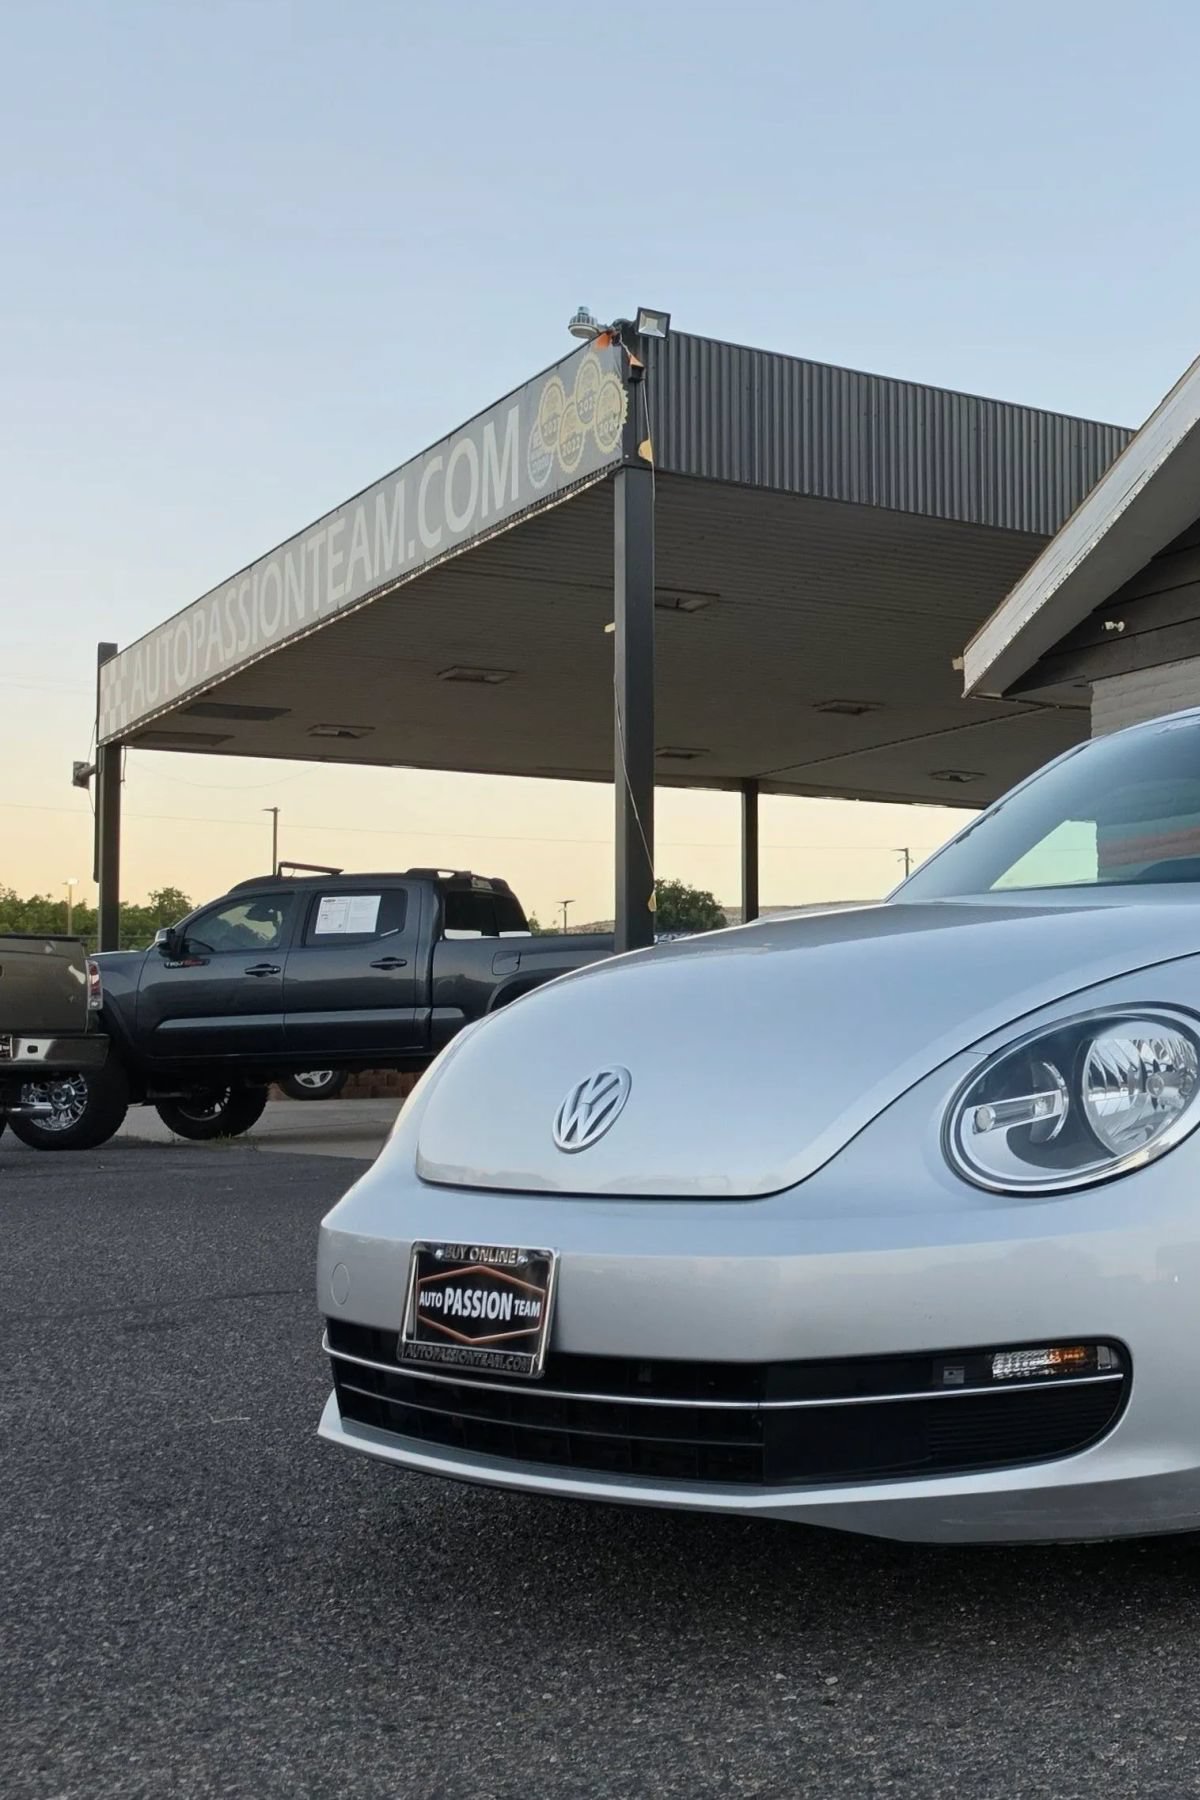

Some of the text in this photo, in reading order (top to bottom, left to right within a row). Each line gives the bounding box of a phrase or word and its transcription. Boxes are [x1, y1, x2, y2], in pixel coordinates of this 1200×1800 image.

[130, 404, 520, 714] AUTOPASSIONTEAM.COM
[444, 1245, 516, 1264] BUY ONLINE
[419, 1287, 541, 1321] AUTO PASSION TEAM
